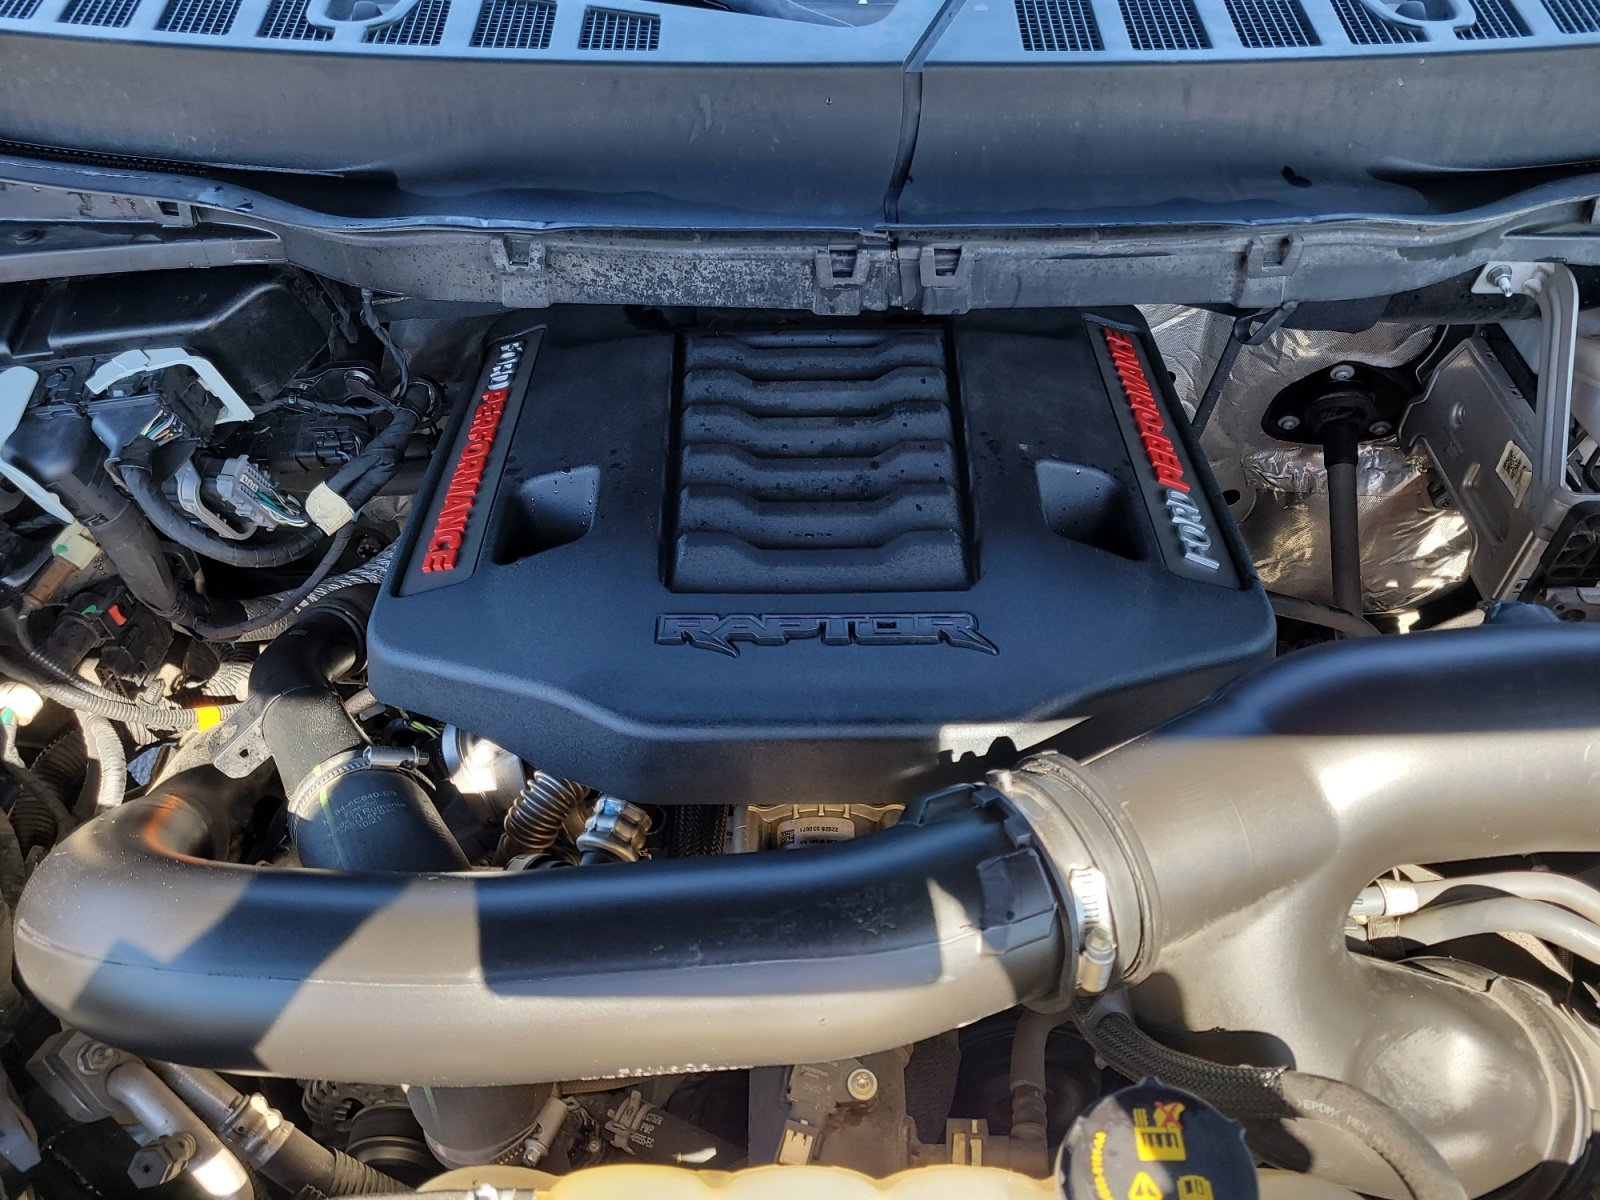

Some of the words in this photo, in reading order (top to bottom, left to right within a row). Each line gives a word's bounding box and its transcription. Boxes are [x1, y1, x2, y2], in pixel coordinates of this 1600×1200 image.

[487, 340, 526, 391] FORD
[1104, 327, 1191, 493] PERFORMANCE
[421, 388, 508, 573] PERFORMANCE
[1165, 488, 1221, 571] FORD
[655, 611, 1000, 659] RAPTOR
